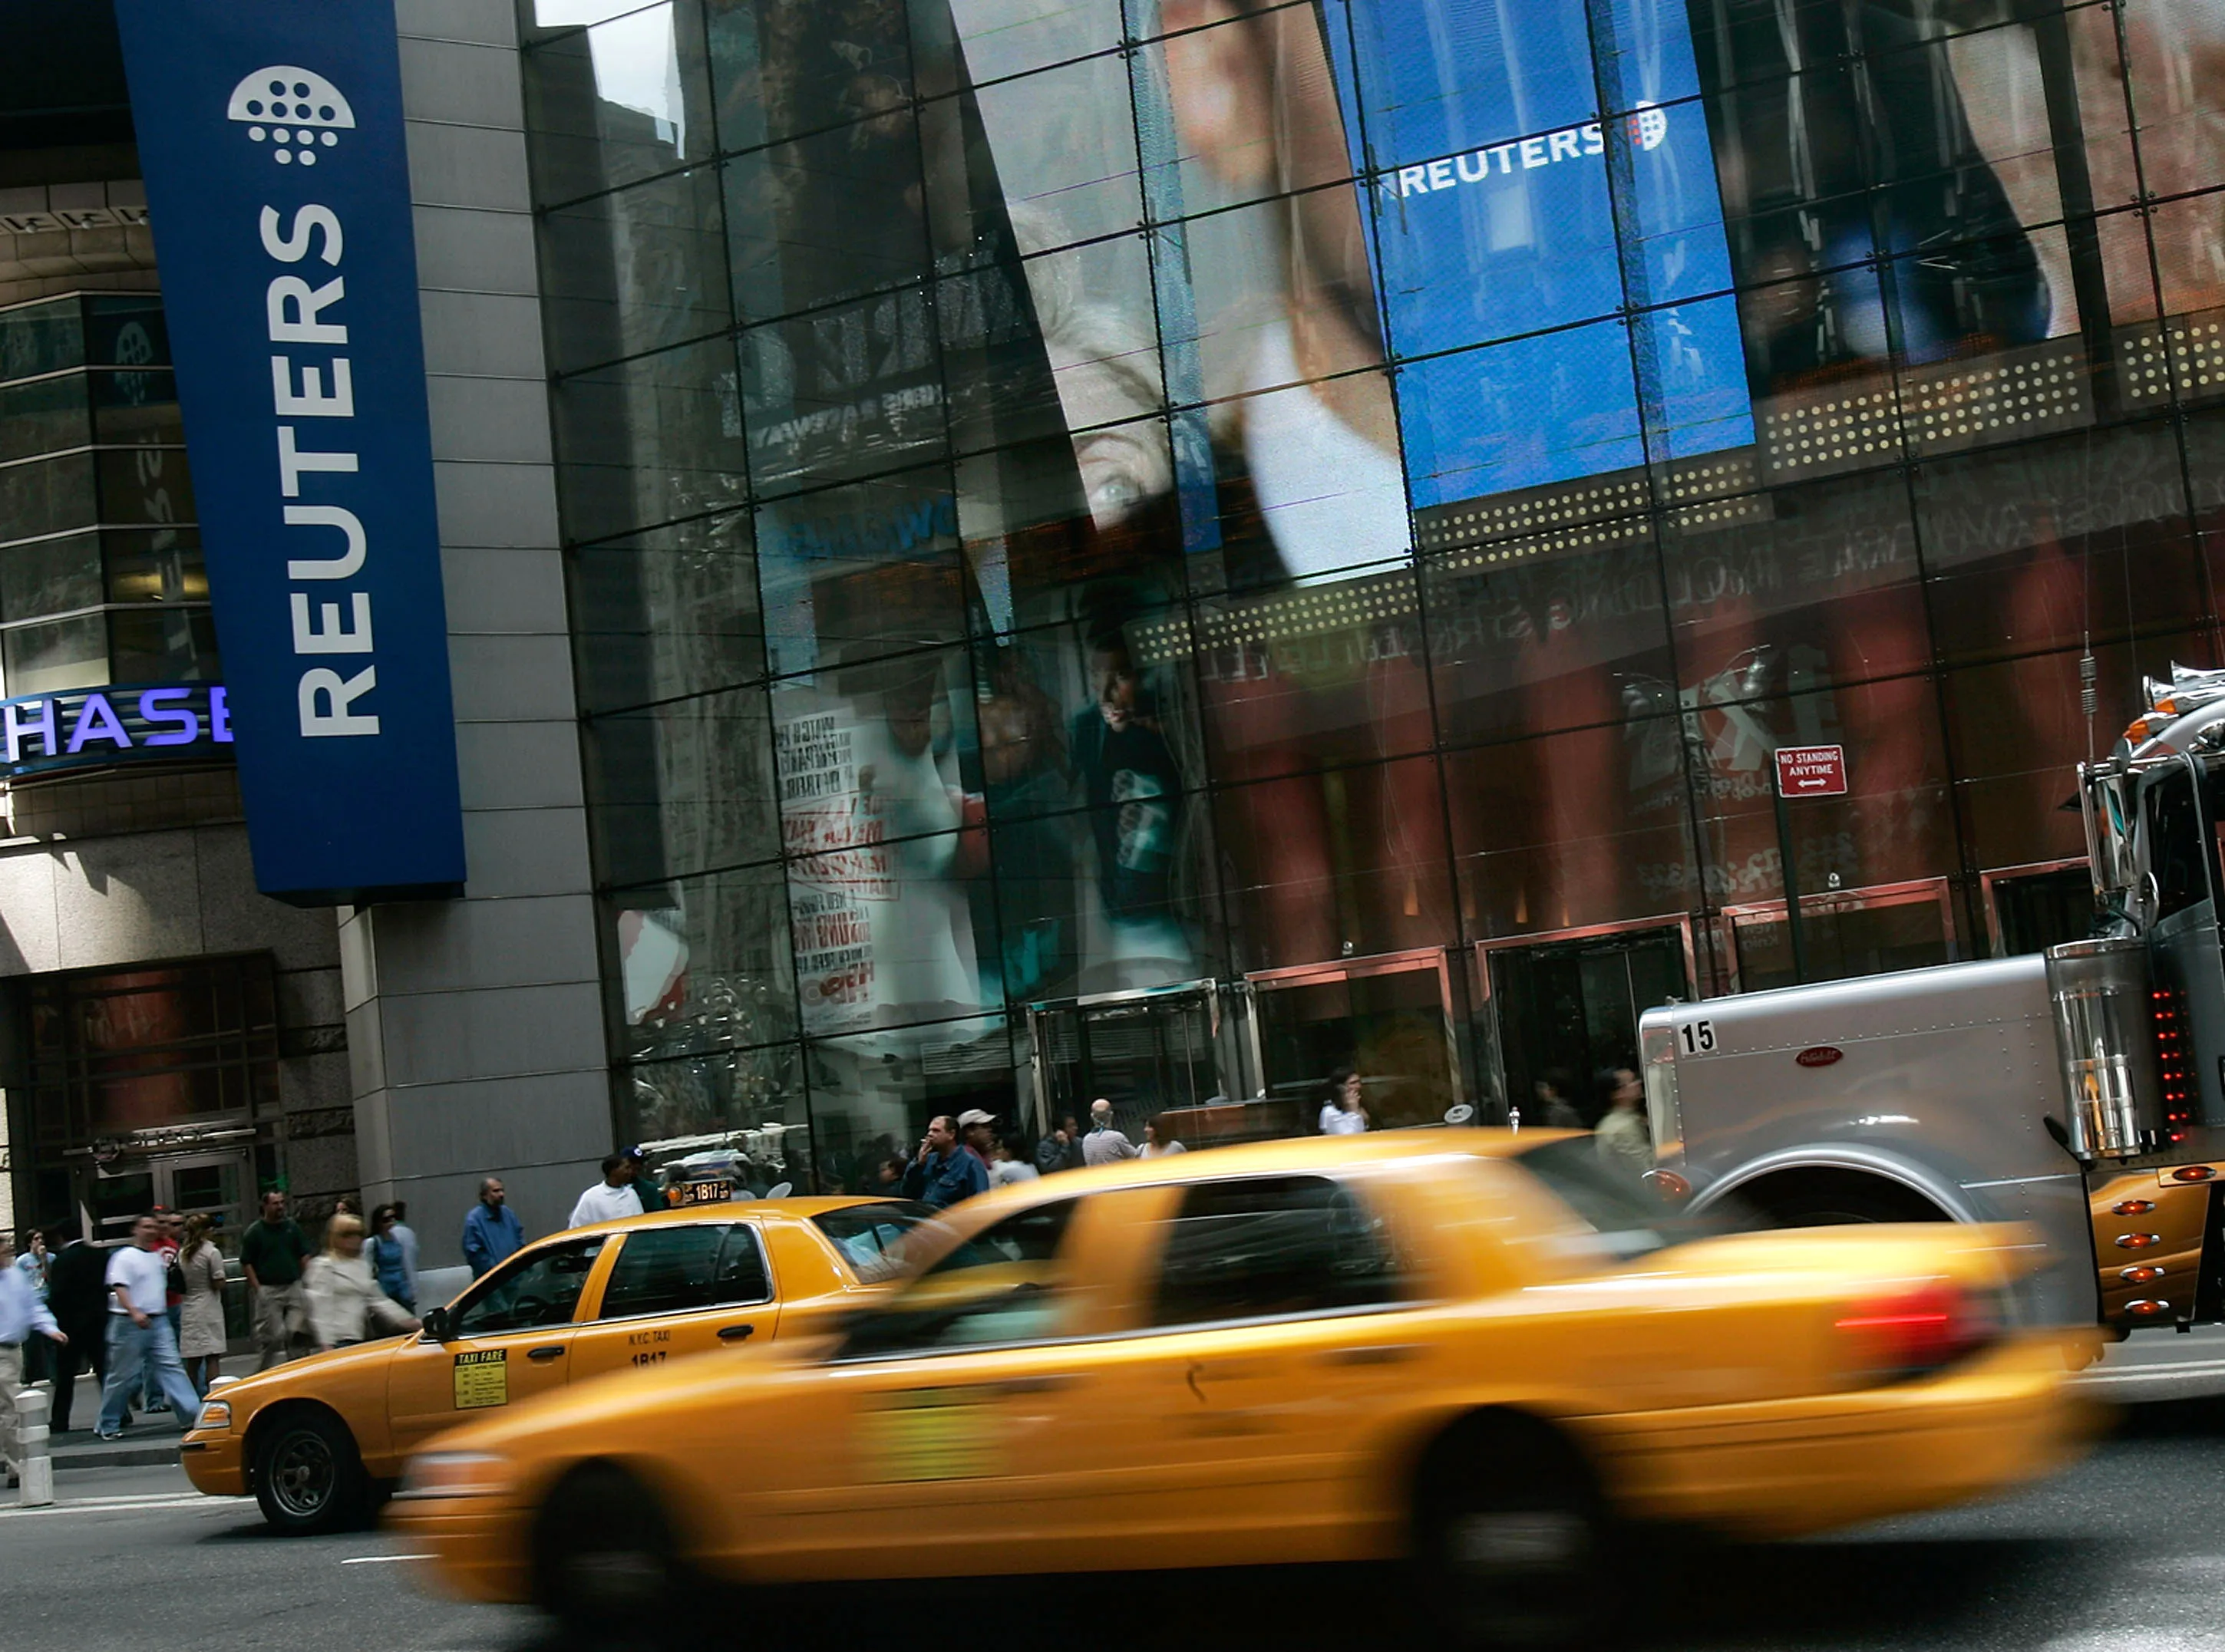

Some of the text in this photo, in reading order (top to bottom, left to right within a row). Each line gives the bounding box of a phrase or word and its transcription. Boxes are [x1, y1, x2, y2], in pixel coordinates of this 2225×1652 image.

[1399, 123, 1604, 197] REUTERS
[259, 203, 380, 737] REUTERS
[1, 687, 233, 763] HASE
[1780, 751, 1838, 764] NO STANDING
[1789, 764, 1834, 777] ANYTIME
[1682, 1020, 1714, 1053] 15
[696, 1183, 718, 1200] 1B17
[653, 1330, 671, 1342] TAXI
[459, 1350, 504, 1364] TAXI FARE
[632, 1351, 667, 1368] 1B17
